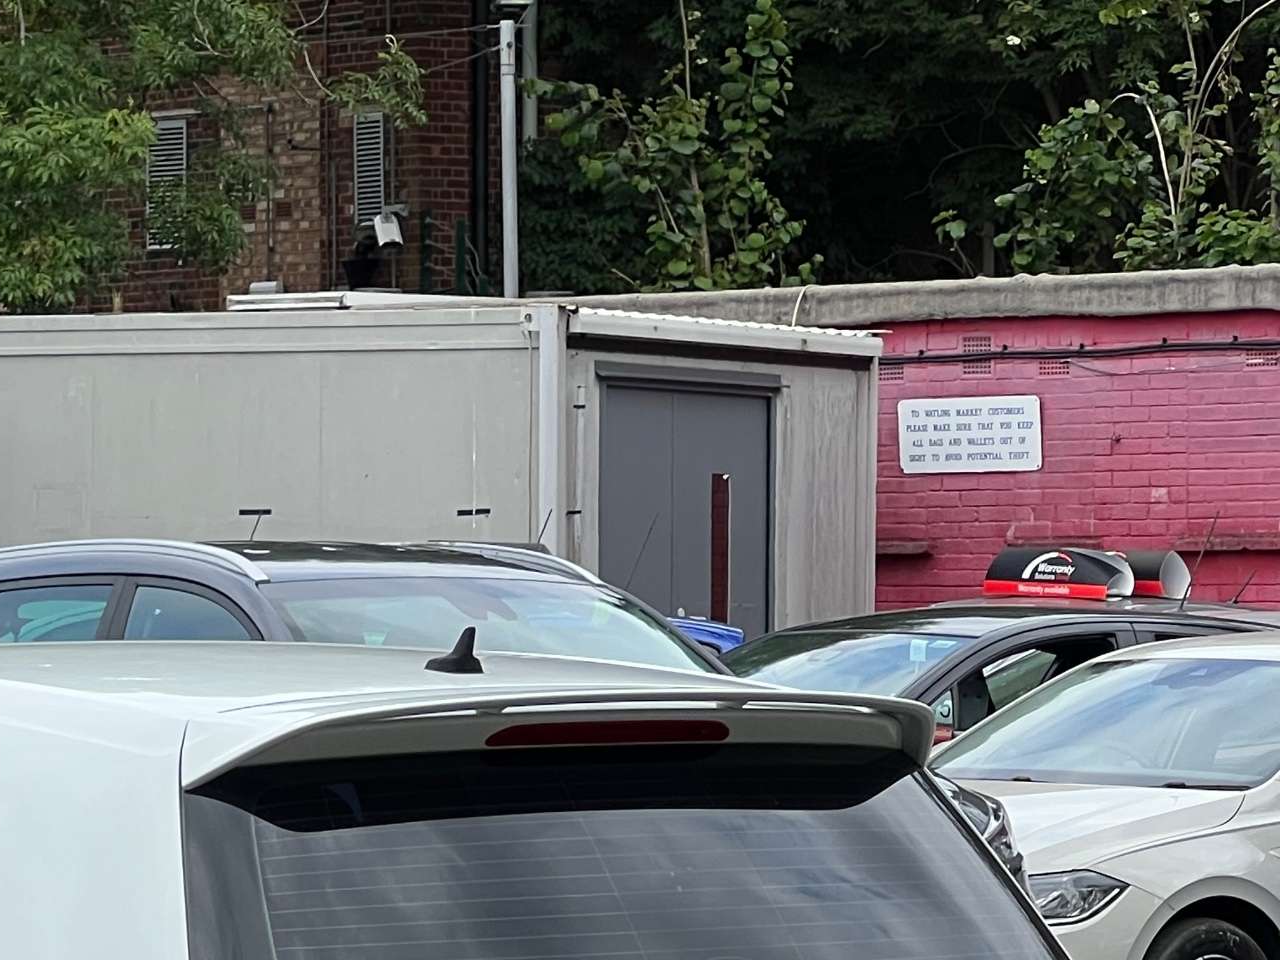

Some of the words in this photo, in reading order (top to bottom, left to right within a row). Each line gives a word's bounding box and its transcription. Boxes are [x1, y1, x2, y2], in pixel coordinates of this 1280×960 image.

[906, 424, 928, 432] PLEASE
[933, 423, 951, 432] MAKE
[956, 423, 972, 431] SURE
[977, 422, 994, 431] THAT
[999, 422, 1012, 430] YOU
[1017, 421, 1034, 430] KEEP
[912, 439, 923, 447] ALL
[928, 438, 944, 447] BAGS
[948, 438, 962, 447] AND
[966, 437, 995, 446] WALLETS
[999, 437, 1013, 445] OUT
[1018, 436, 1026, 444] OF
[931, 453, 940, 462] TO
[966, 452, 1003, 461] POTENTIAL
[1008, 451, 1030, 460] THEFT
[1037, 562, 1076, 576] Warranty
